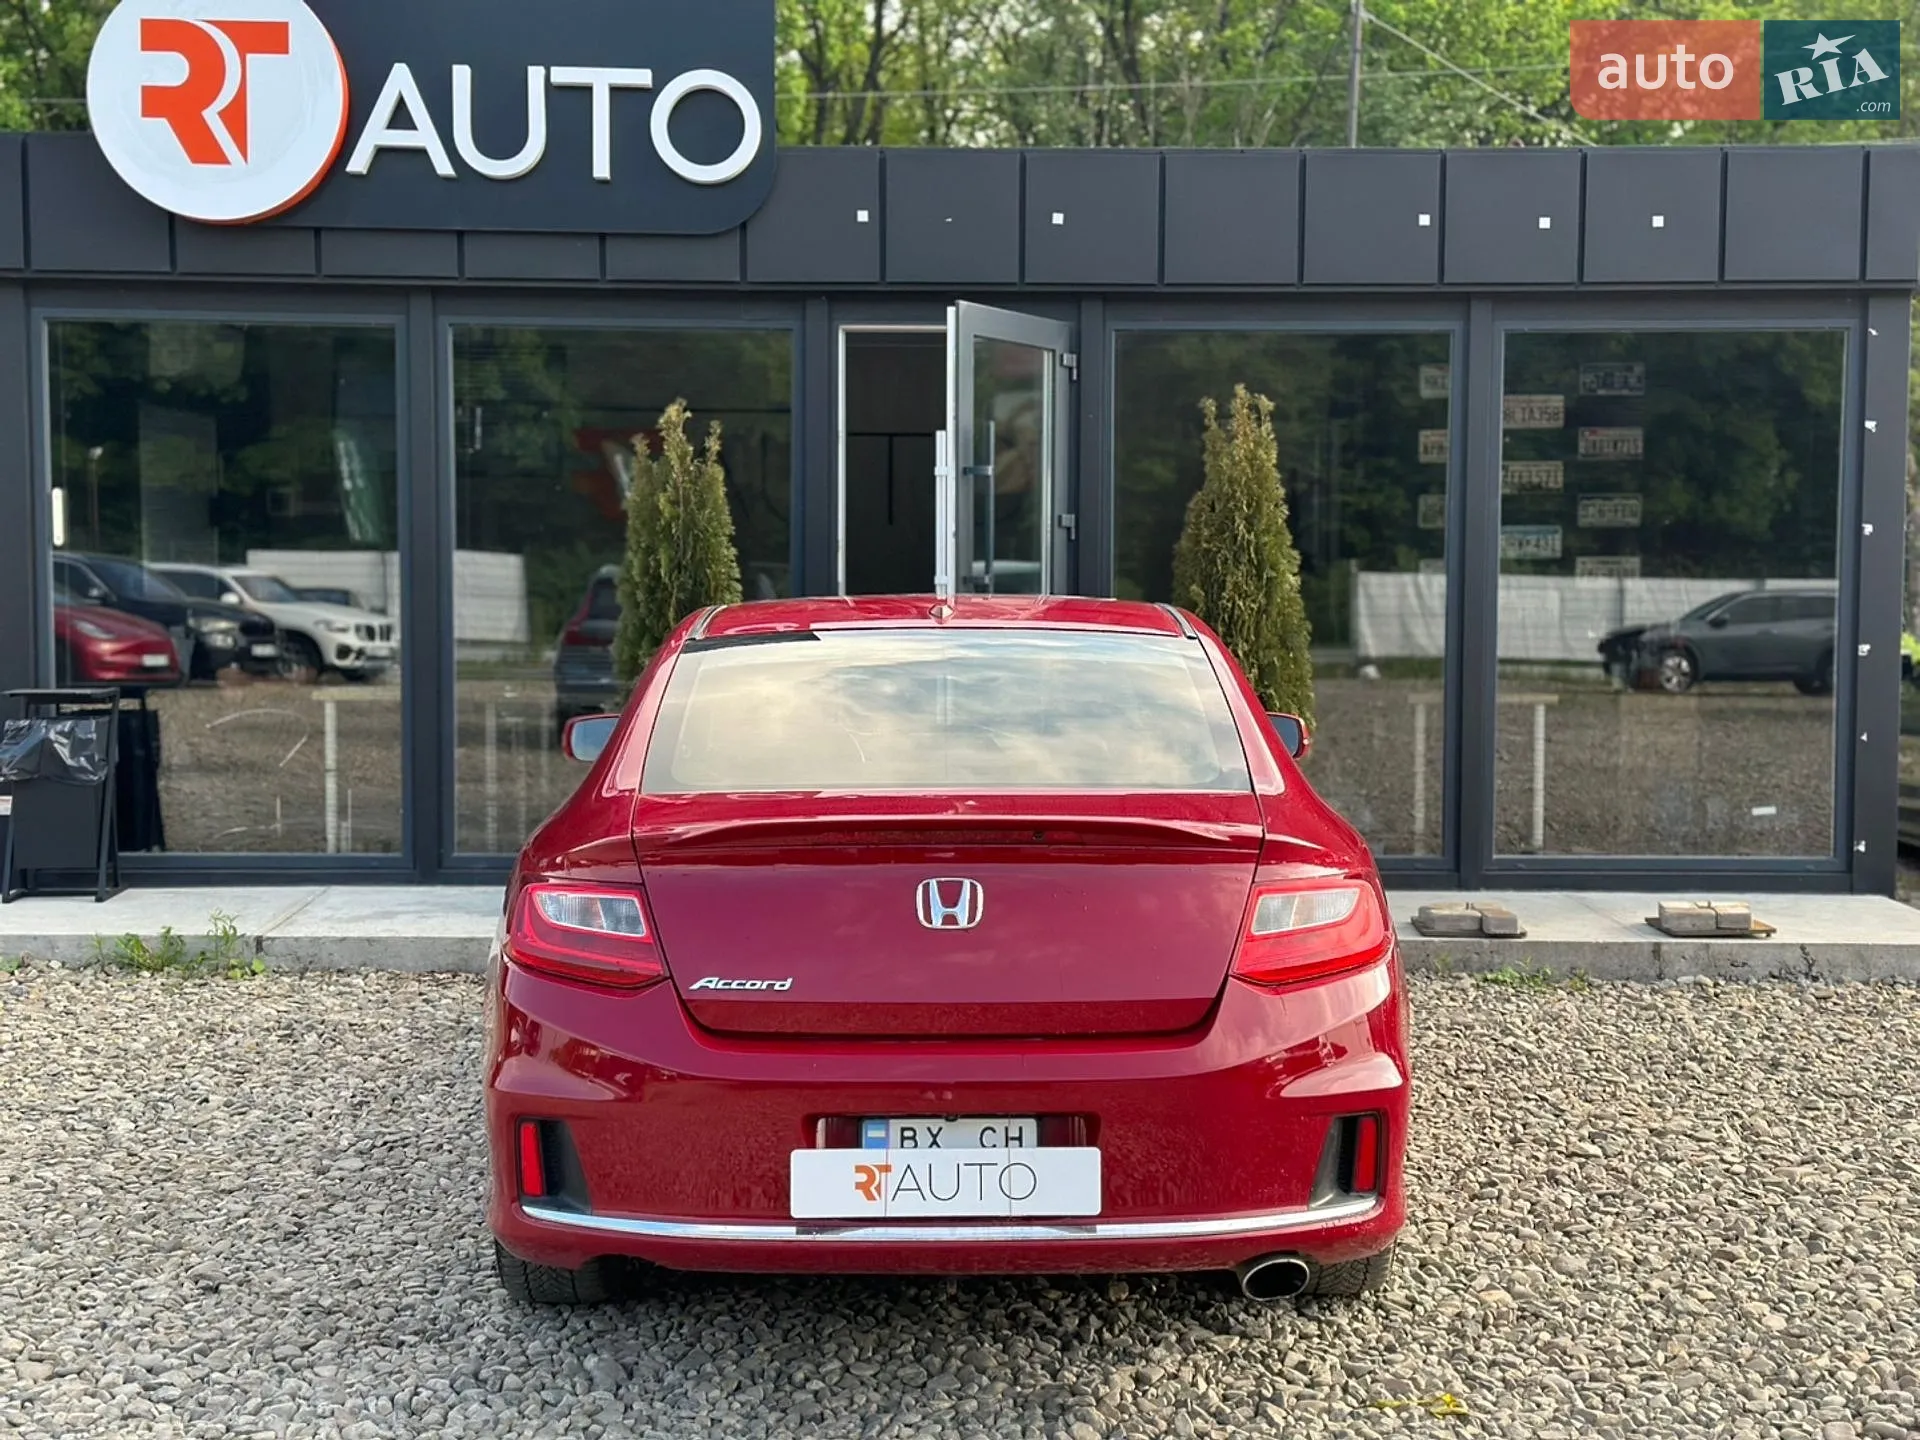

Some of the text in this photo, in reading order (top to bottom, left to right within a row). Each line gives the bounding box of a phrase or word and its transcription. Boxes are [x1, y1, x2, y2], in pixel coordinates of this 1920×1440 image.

[139, 17, 762, 185] RT AUTO
[688, 976, 794, 991] Accord
[900, 1126, 1024, 1149] BX CH
[854, 1162, 1038, 1201] RT AUTO
